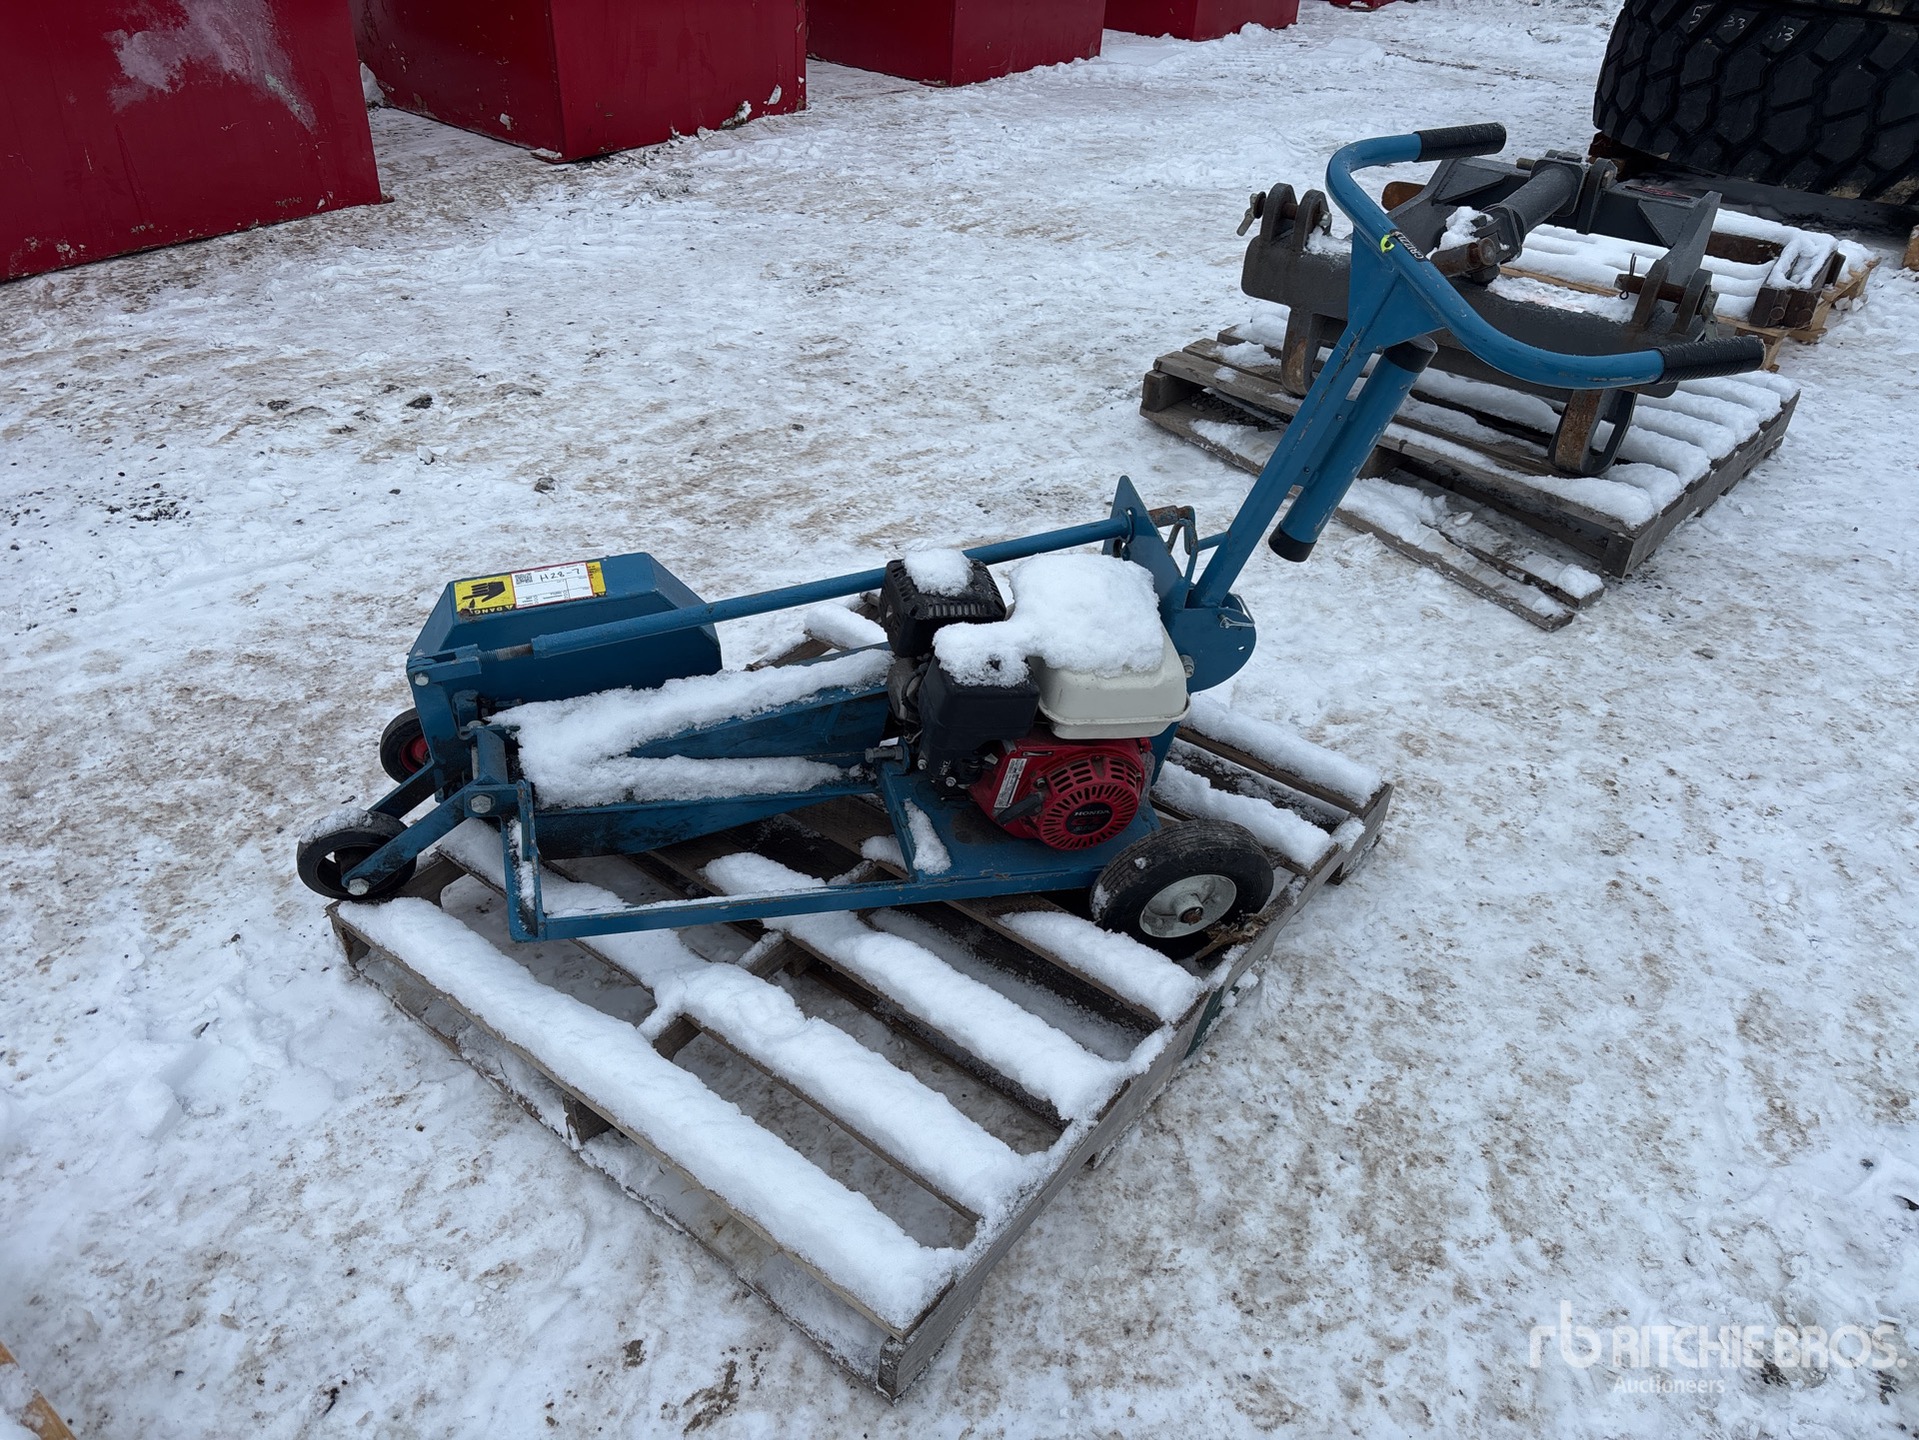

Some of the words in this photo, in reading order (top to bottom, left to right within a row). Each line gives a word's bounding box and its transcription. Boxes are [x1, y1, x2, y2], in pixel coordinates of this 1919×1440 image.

[540, 568, 580, 583] H28-7
[470, 605, 503, 615] DANG
[1074, 809, 1111, 817] HONDA
